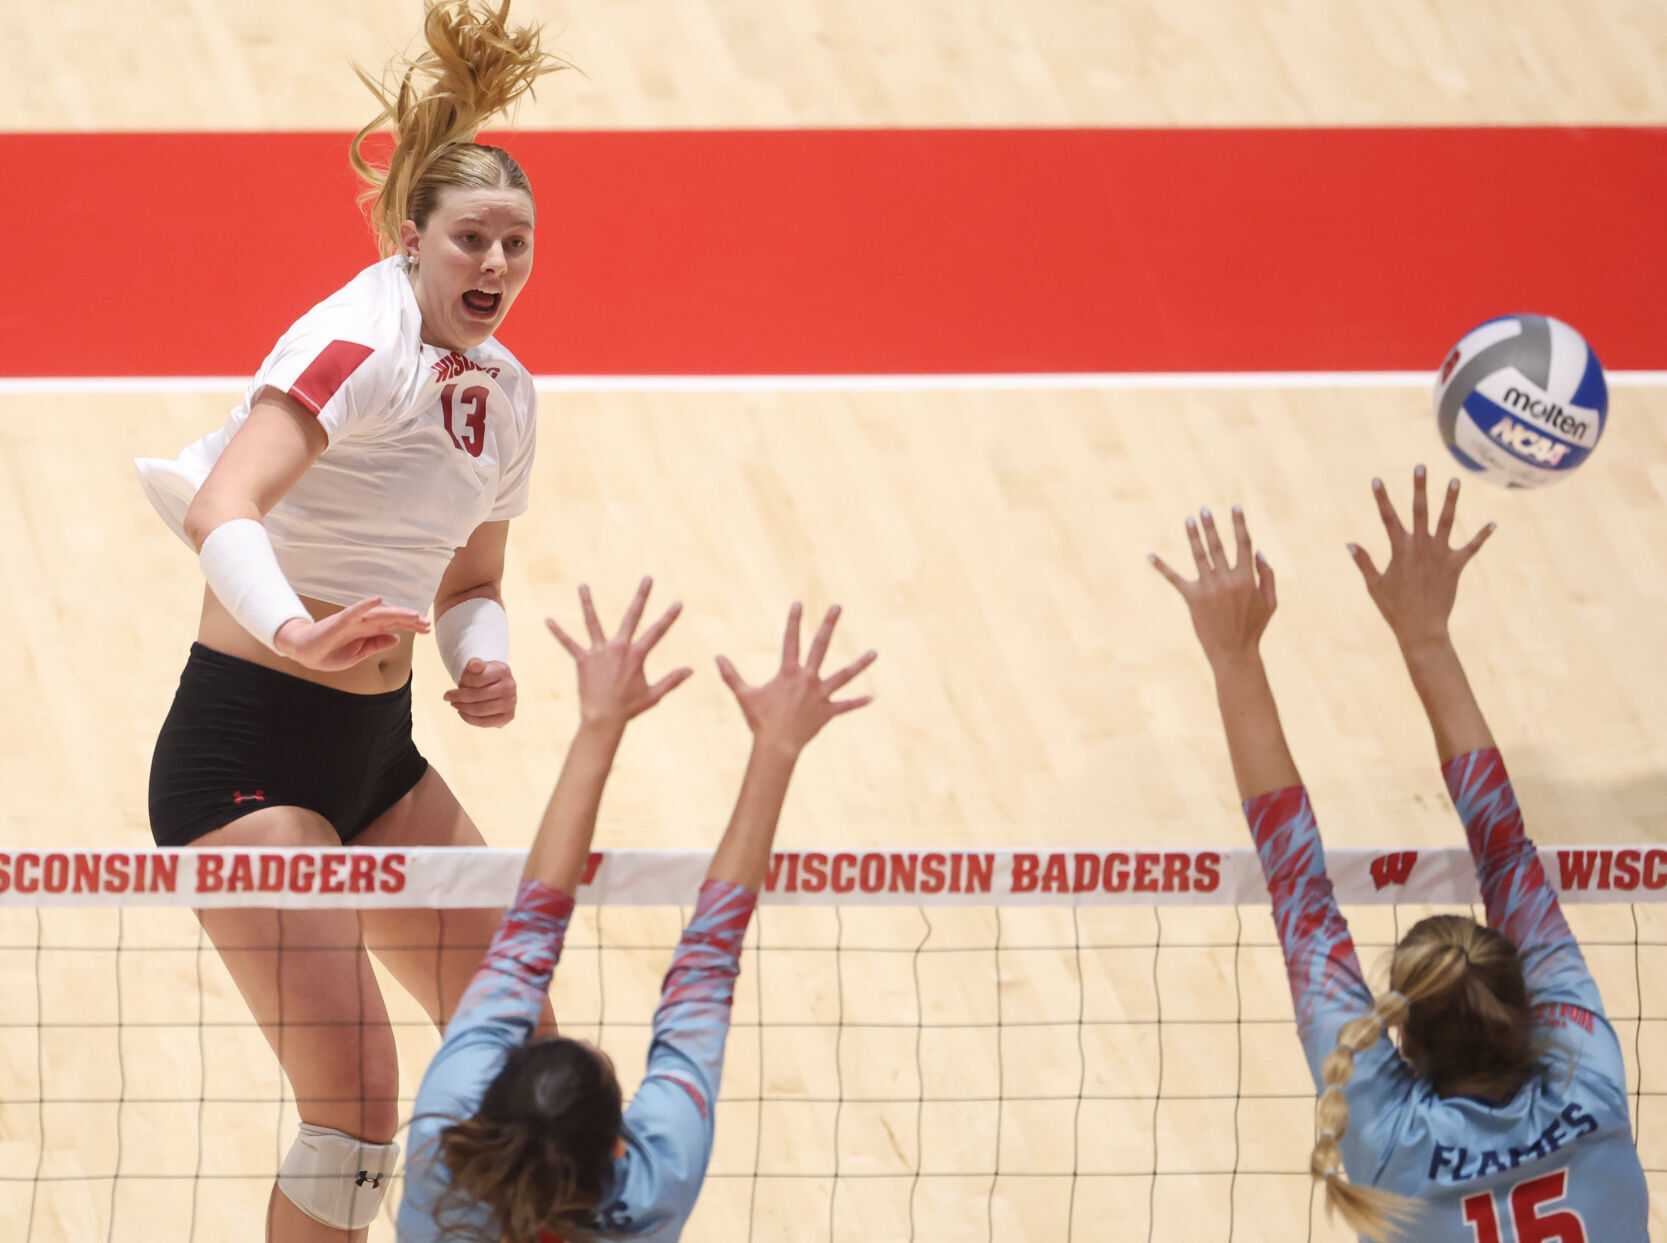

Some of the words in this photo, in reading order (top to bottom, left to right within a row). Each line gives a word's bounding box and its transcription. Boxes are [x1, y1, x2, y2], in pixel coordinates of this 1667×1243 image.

[441, 383, 490, 458] 13
[1503, 387, 1588, 441] molten
[195, 853, 407, 894] BADGERS
[1010, 852, 1221, 893] BADGERS
[1428, 1102, 1598, 1181] FLAMES
